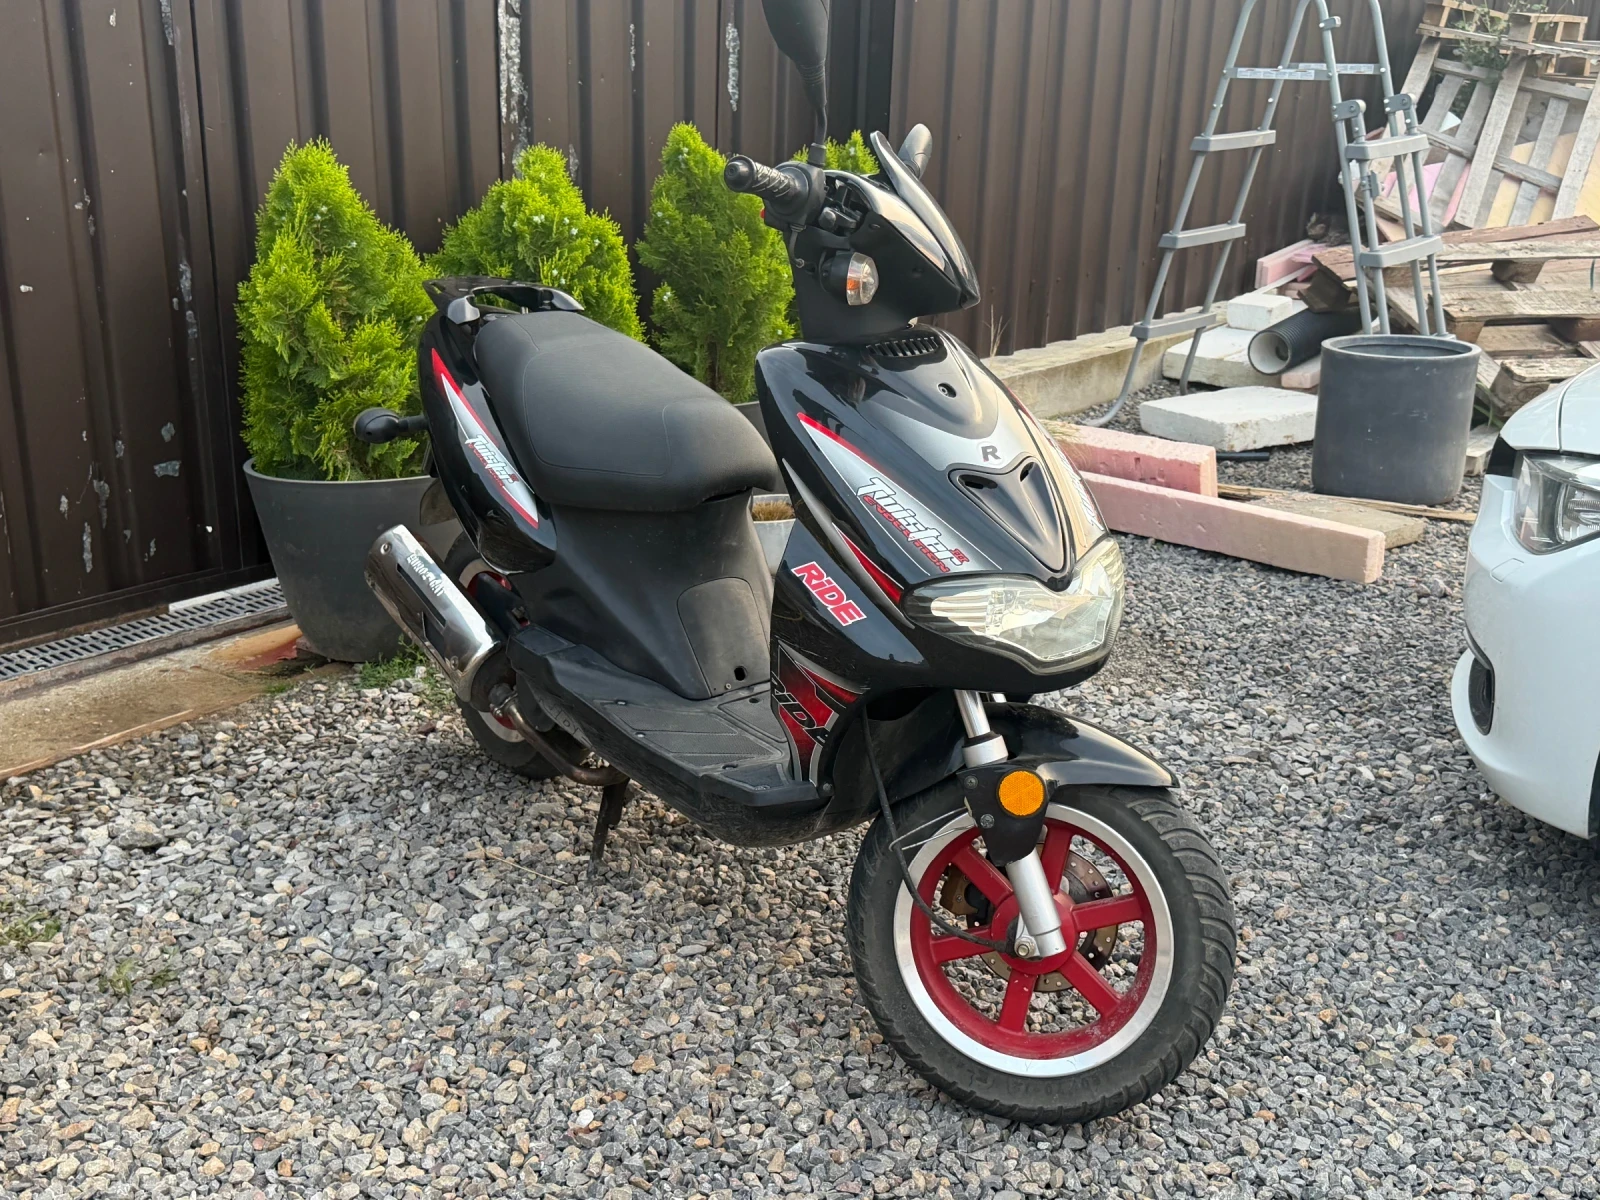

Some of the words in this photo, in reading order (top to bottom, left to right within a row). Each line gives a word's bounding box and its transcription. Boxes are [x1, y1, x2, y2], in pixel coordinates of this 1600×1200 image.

[465, 434, 515, 484] Twister
[981, 445, 1001, 462] R
[856, 477, 963, 566] Twister
[862, 495, 951, 573] EVOLUTION
